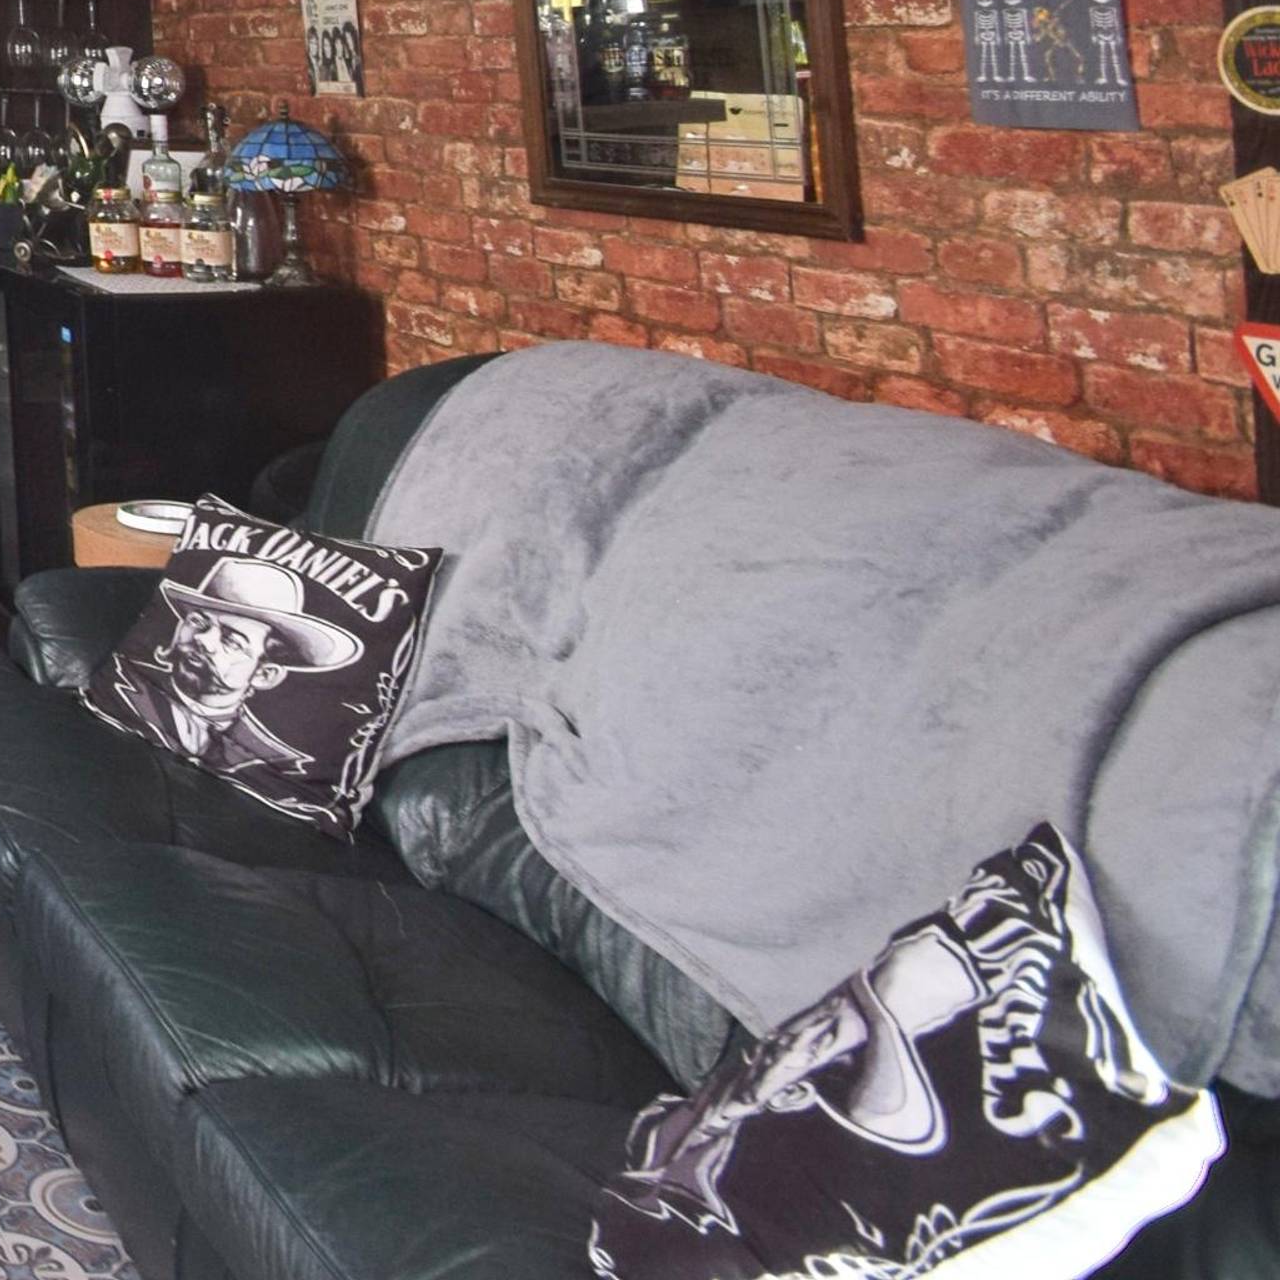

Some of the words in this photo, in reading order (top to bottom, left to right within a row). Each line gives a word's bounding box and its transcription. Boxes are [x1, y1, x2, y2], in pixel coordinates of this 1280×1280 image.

[981, 89, 1000, 101] IT'S
[1002, 90, 1013, 101] A
[1013, 89, 1075, 102] DIFFERENT
[1078, 89, 1127, 103] ABILITY
[172, 514, 264, 555] JACK
[257, 528, 411, 623] DANIEL'S
